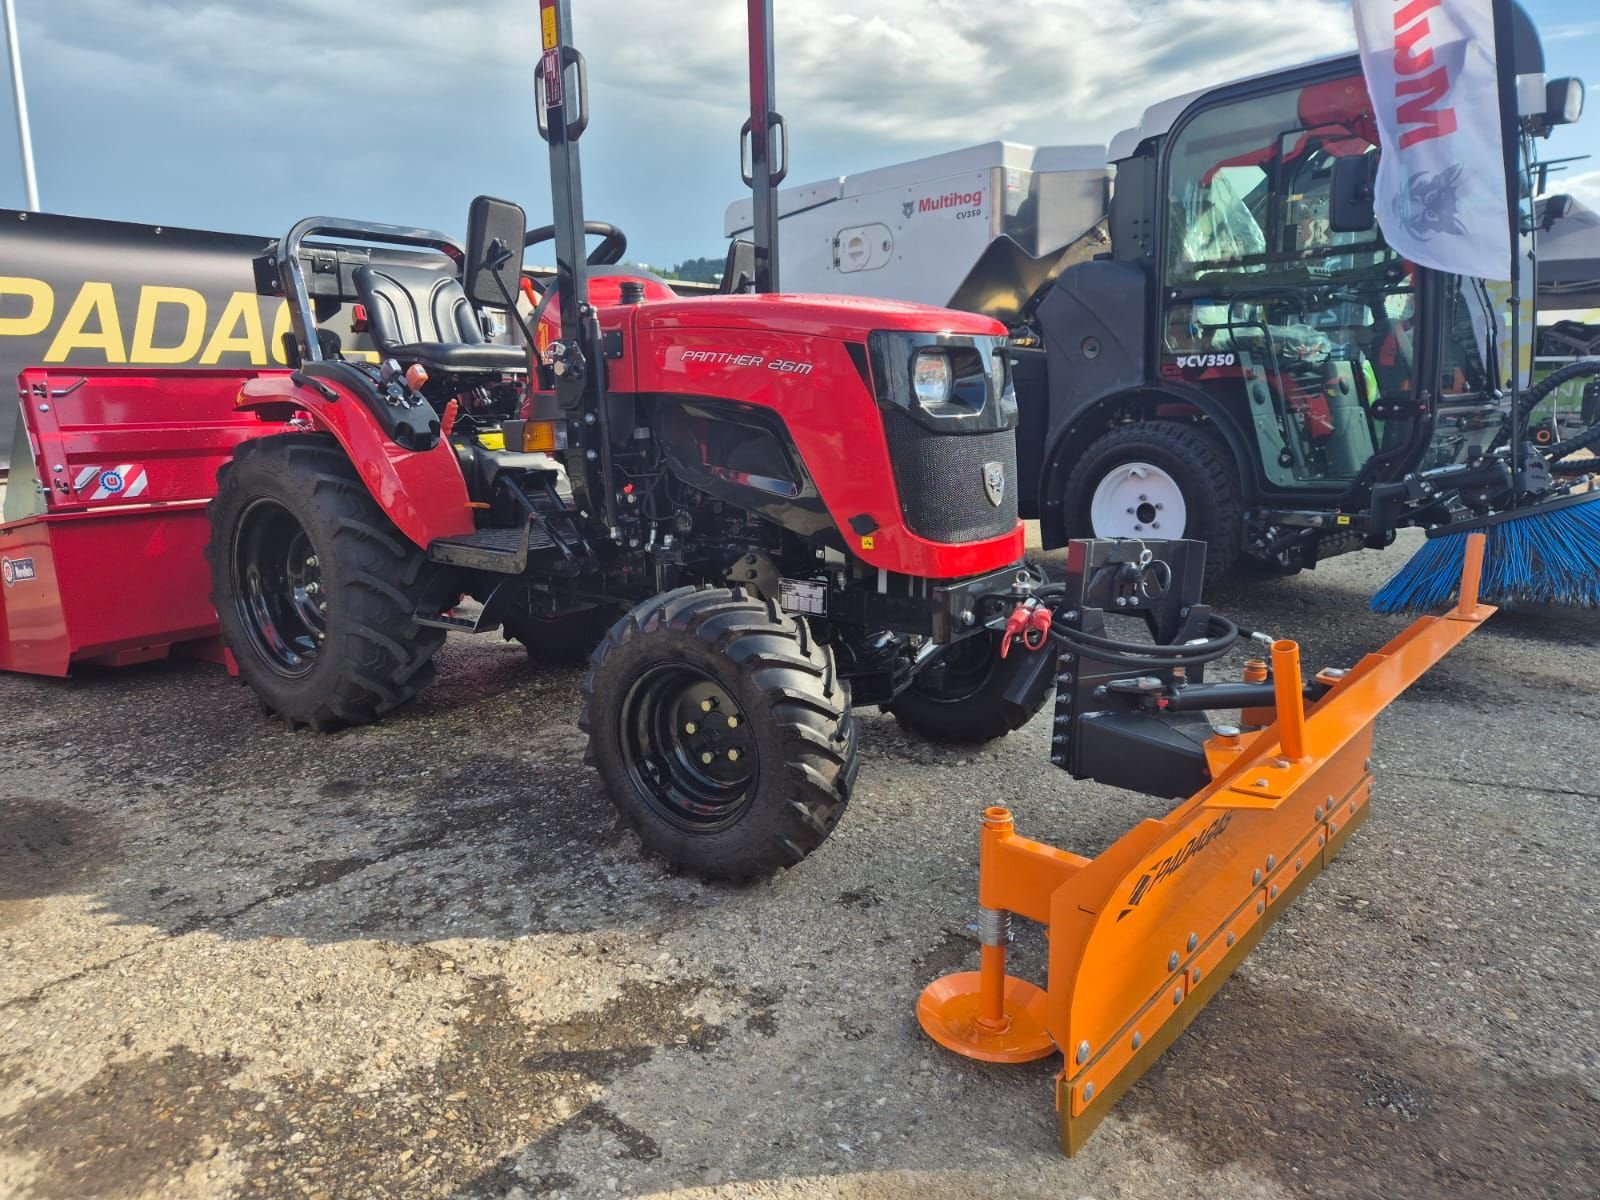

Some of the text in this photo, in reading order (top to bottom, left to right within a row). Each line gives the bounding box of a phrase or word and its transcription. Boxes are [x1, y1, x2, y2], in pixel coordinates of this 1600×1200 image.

[918, 190, 982, 213] Multihog
[956, 209, 982, 220] CV350
[681, 350, 813, 375] PANTHER 26M
[1186, 353, 1235, 368] CV350
